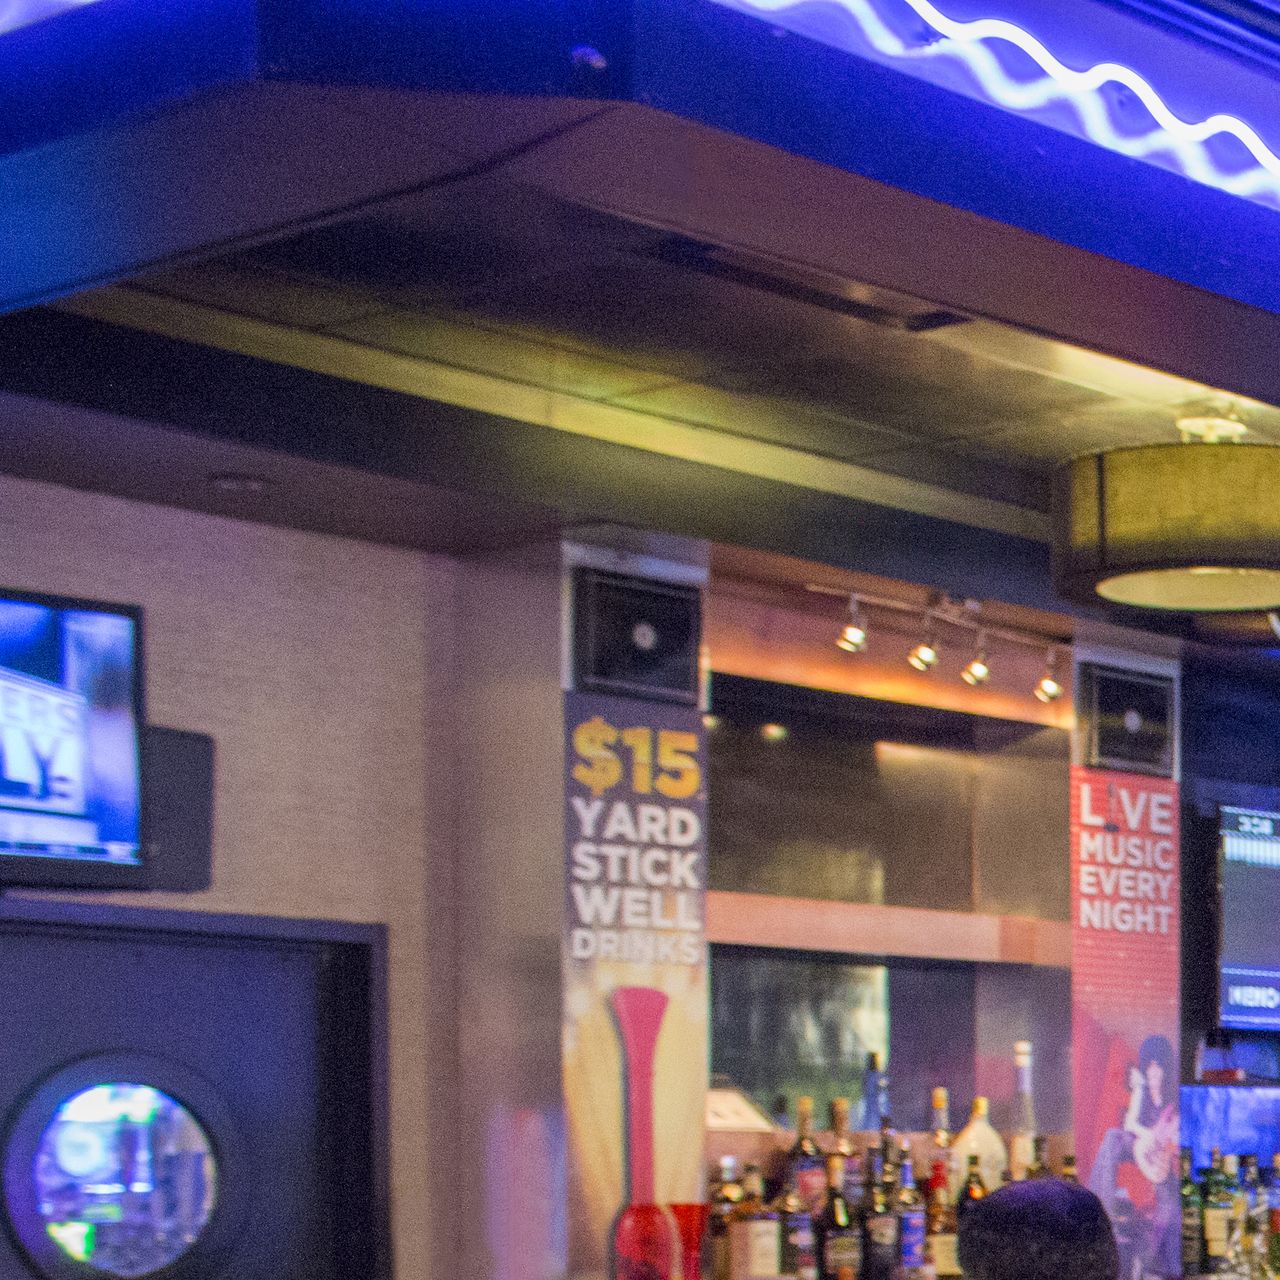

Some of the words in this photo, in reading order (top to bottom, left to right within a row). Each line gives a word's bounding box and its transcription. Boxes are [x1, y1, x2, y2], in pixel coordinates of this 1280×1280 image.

[572, 715, 701, 799] $15
[572, 796, 700, 847] YARD
[571, 841, 701, 889] STICK
[1079, 831, 1174, 870] MUSIC
[1079, 864, 1174, 900] EVERY
[572, 884, 701, 931] WELL
[1079, 898, 1174, 934] NIGHT
[571, 926, 700, 965] DRINKS
